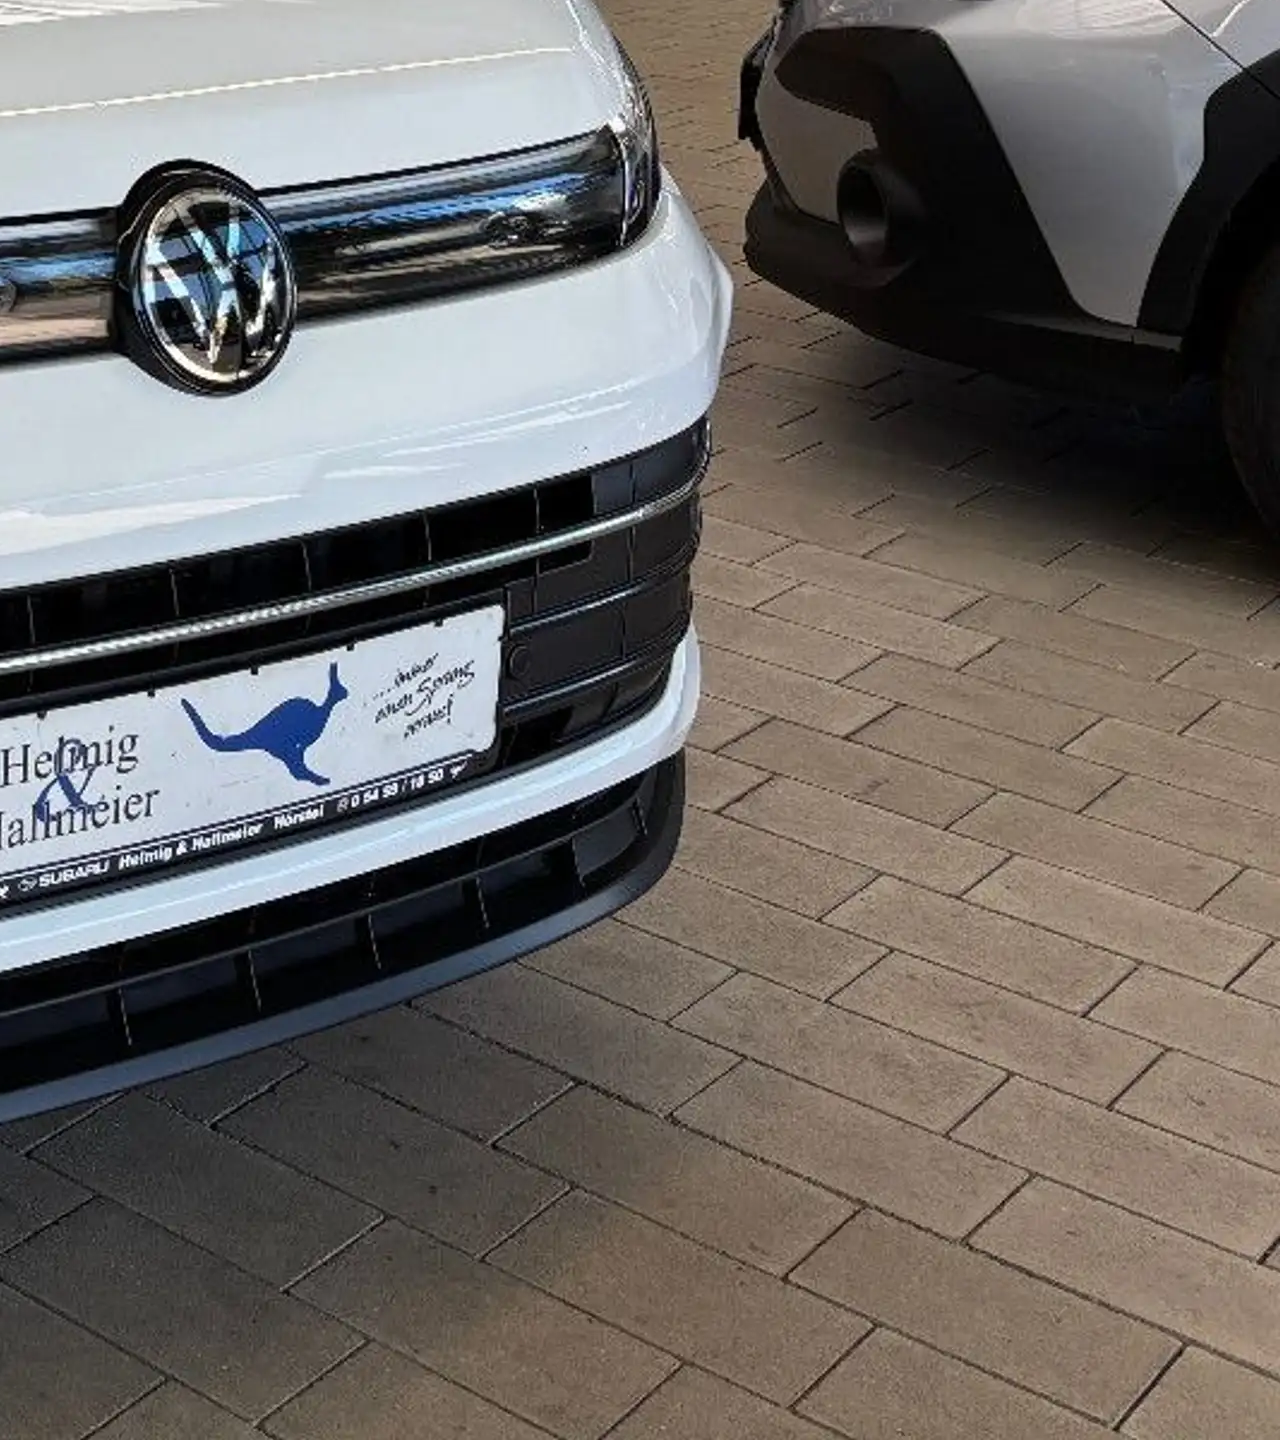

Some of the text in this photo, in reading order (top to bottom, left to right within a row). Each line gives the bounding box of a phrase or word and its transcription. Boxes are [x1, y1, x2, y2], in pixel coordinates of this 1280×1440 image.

[38, 861, 111, 888] SUBARU
[118, 845, 174, 870] Helmig
[192, 822, 264, 852] Hallmeier
